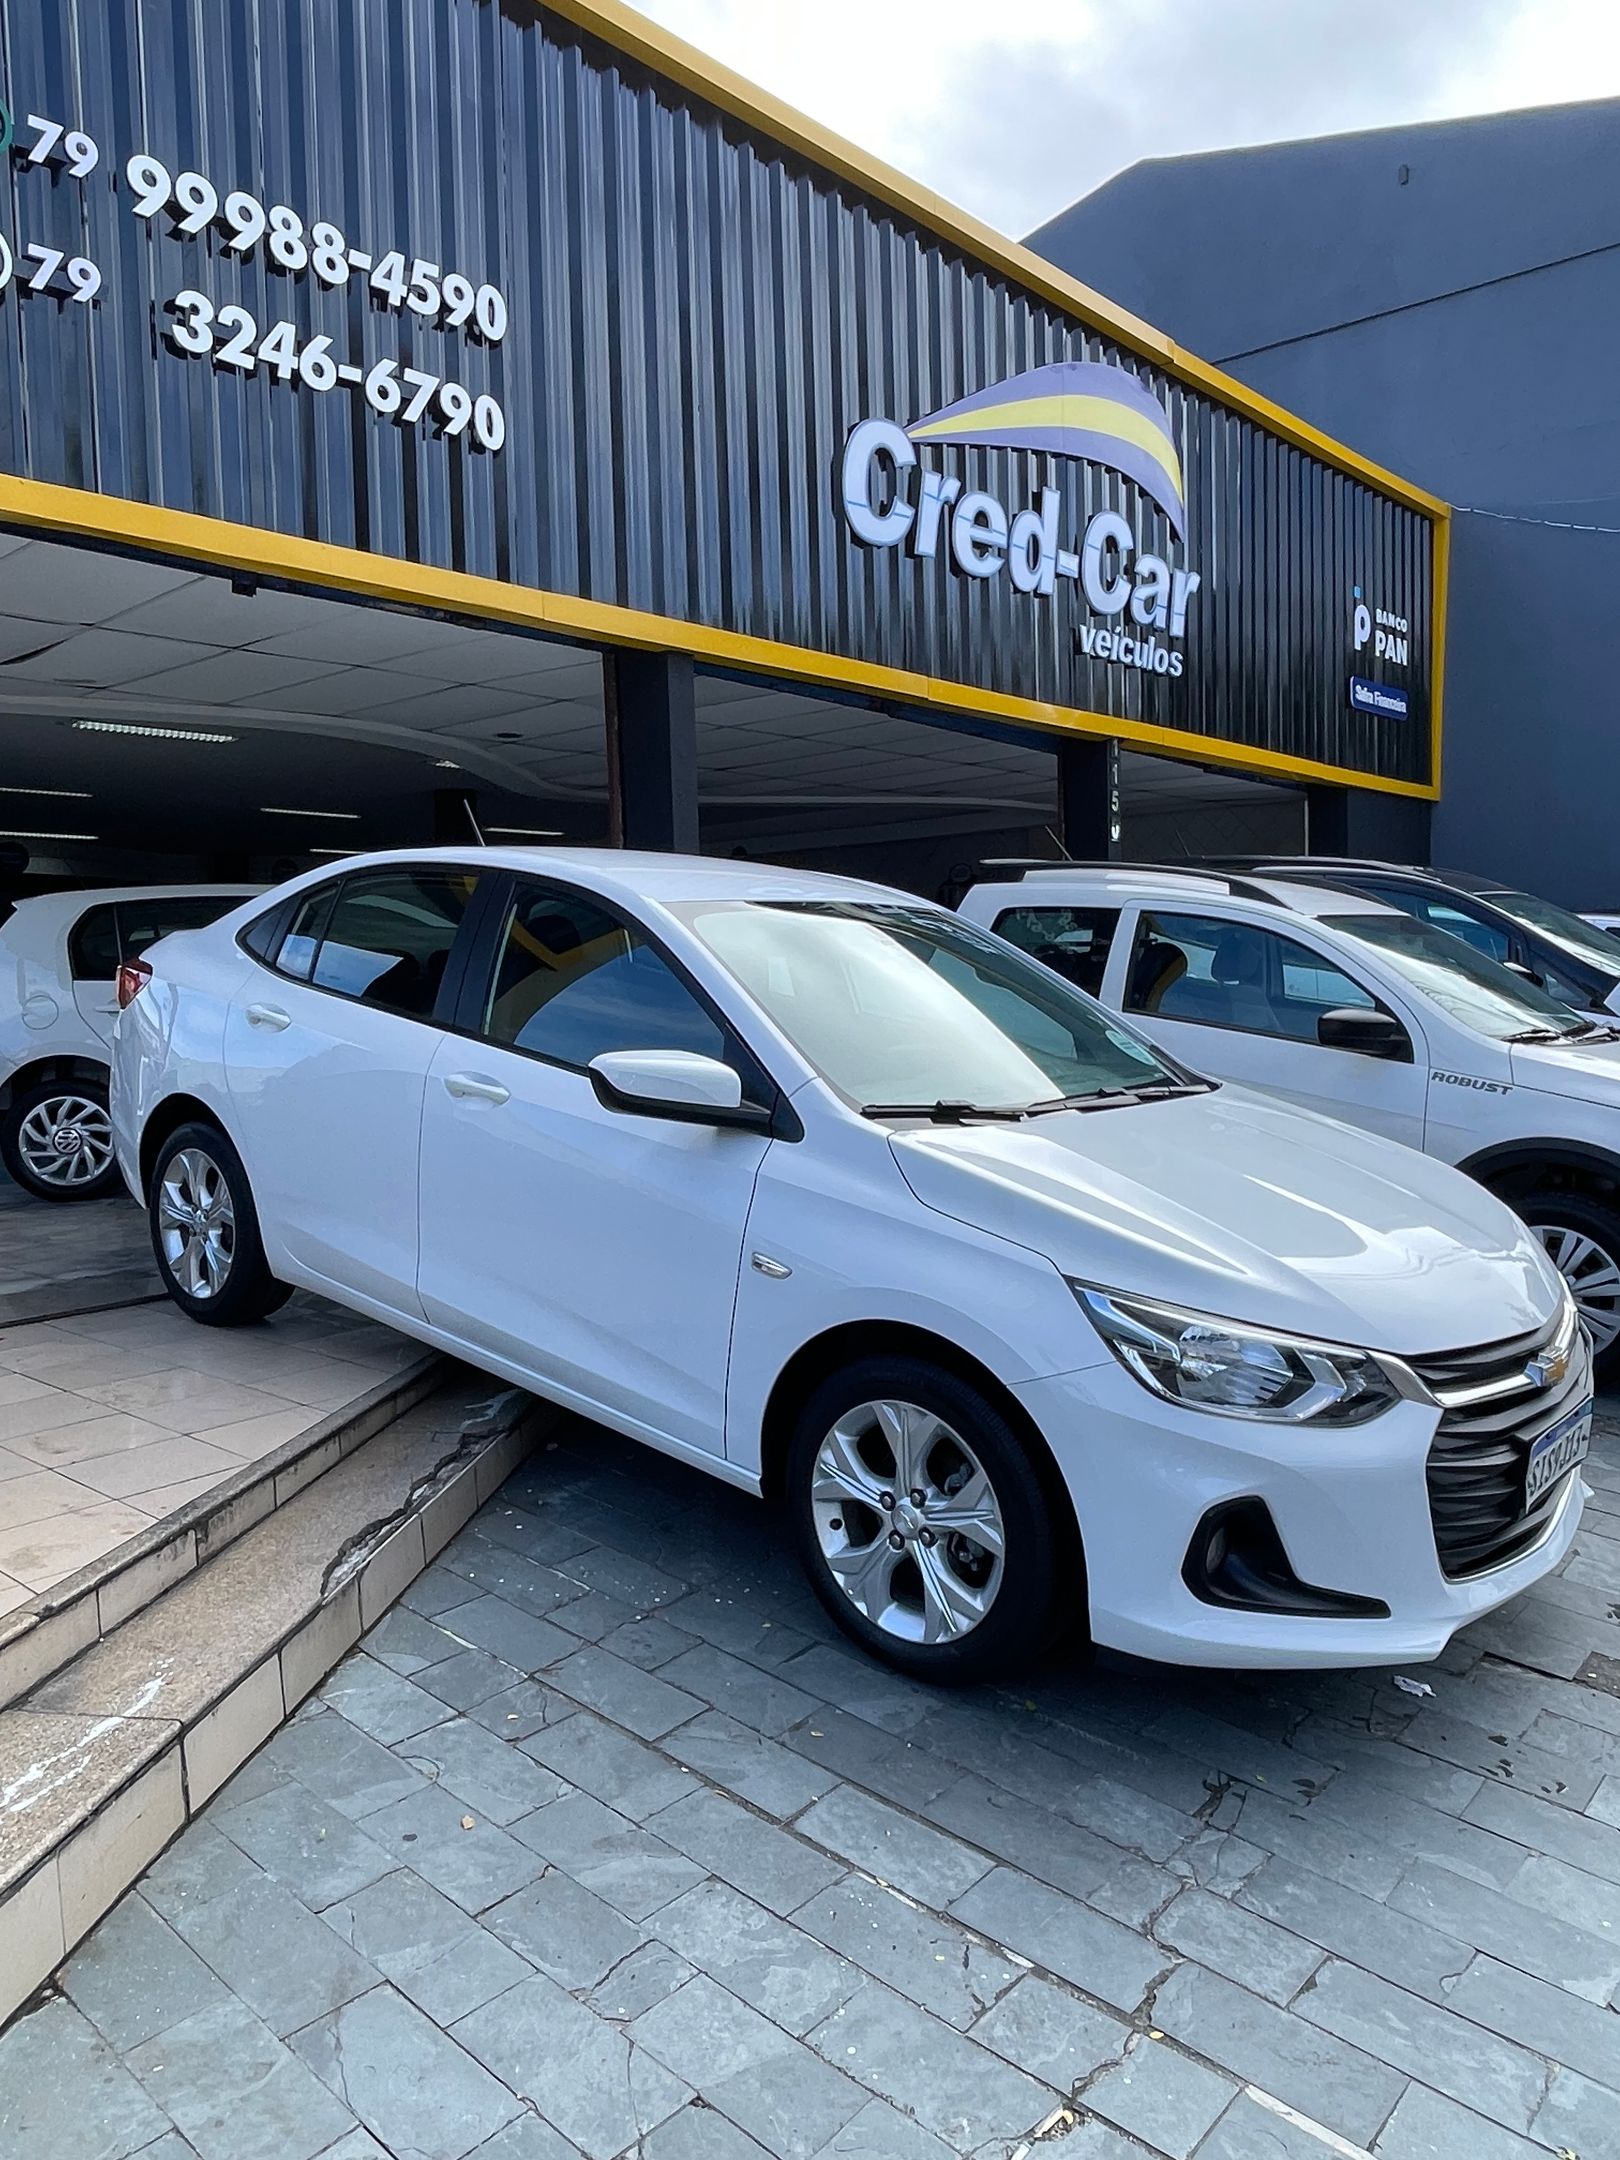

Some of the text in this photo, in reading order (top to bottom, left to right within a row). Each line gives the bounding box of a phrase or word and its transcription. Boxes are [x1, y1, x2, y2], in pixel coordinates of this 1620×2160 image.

[27, 114, 507, 341] 79 99988-4590
[27, 243, 505, 451] 79 3246-6790
[842, 417, 1200, 638] Cred-Car
[1375, 608, 1408, 633] BANCO
[1079, 624, 1183, 678] veículos
[1375, 630, 1408, 666] PAN
[1431, 1072, 1513, 1095] ROBUST
